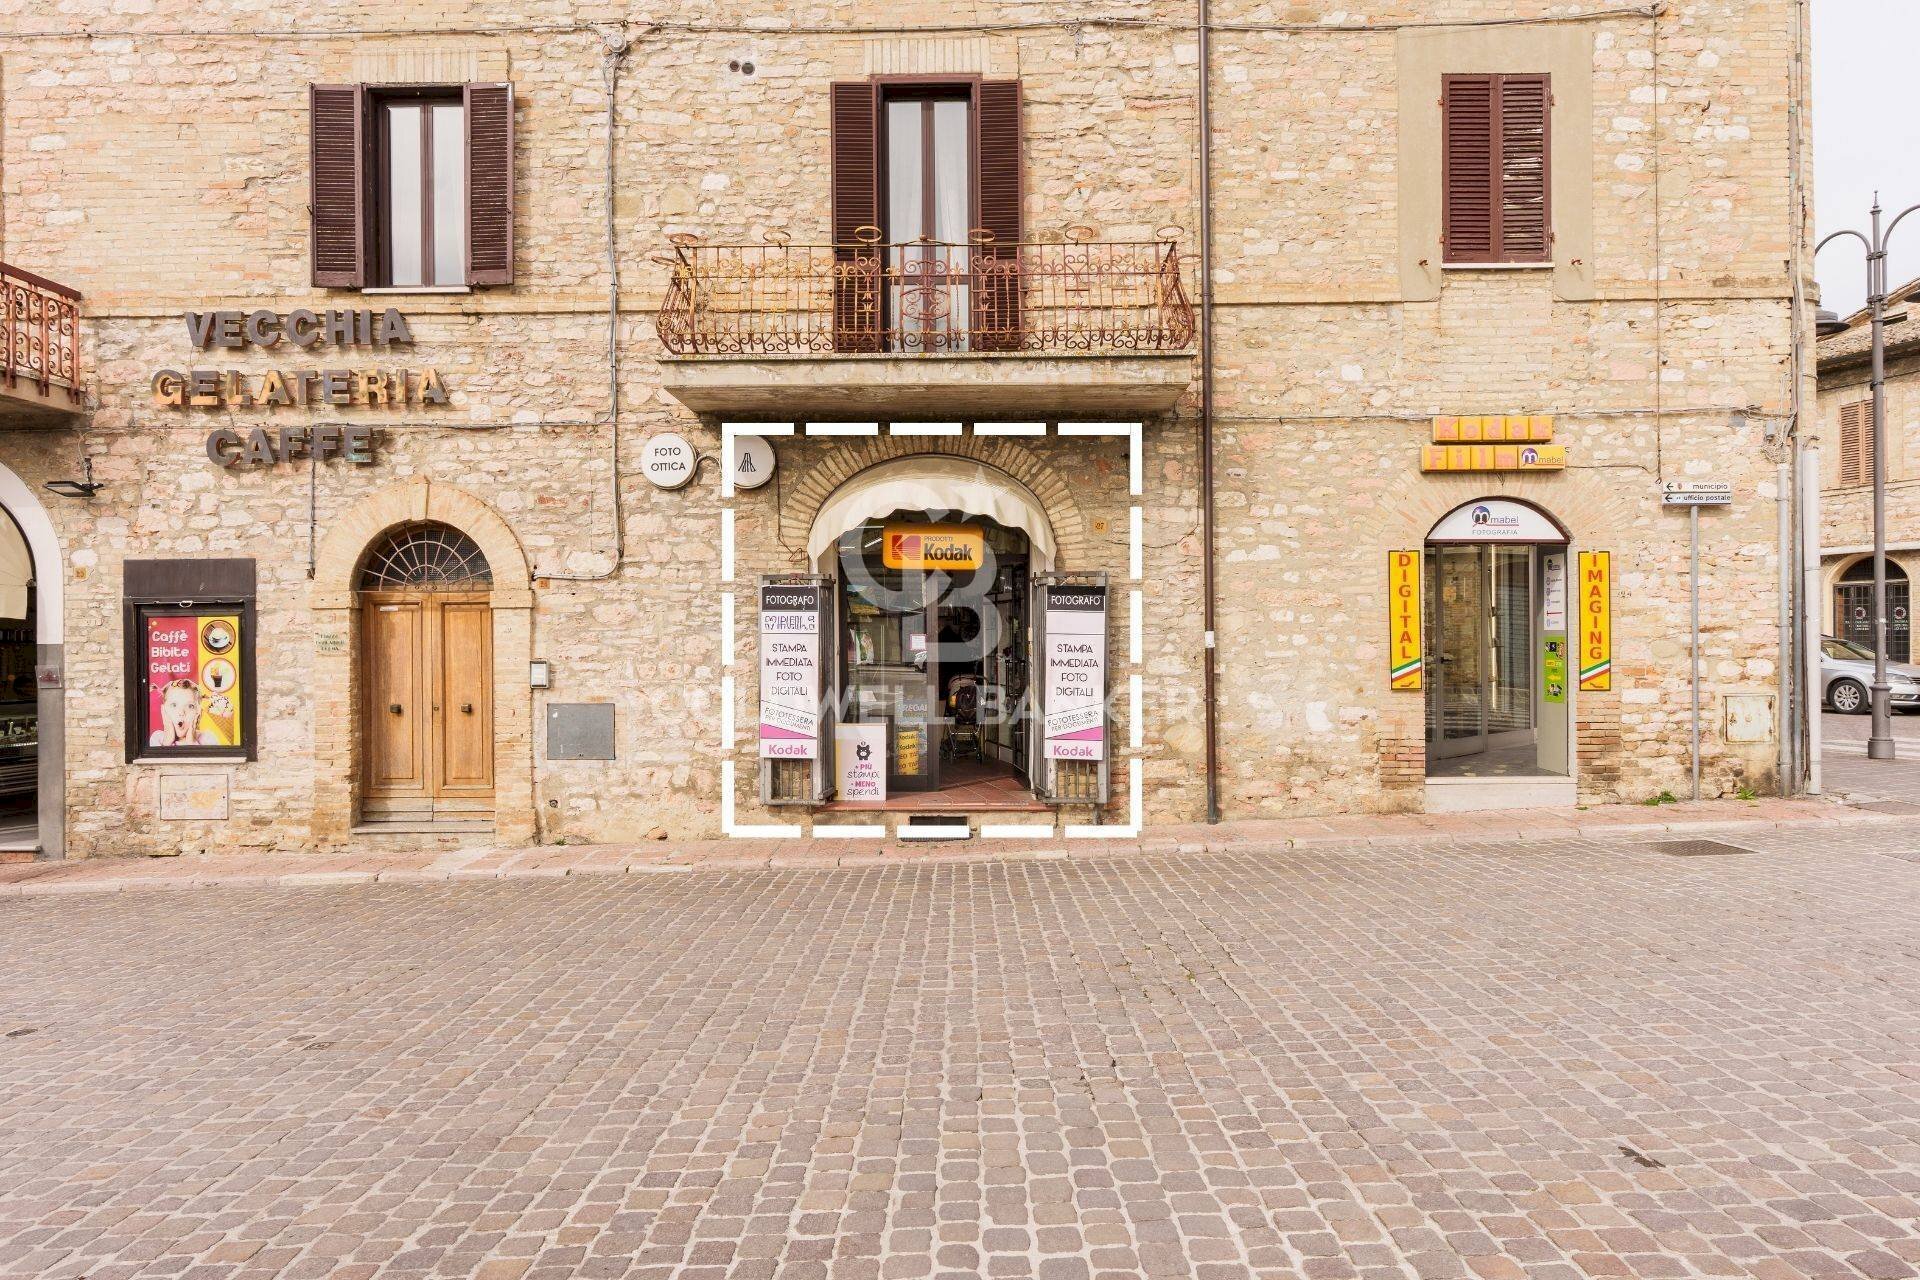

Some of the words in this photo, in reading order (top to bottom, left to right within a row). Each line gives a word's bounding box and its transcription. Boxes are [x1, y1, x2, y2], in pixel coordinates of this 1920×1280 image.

[184, 309, 413, 349] VECCHIA
[151, 369, 450, 406] GELATERIA
[1438, 418, 1549, 439] Kodak
[654, 446, 681, 456] FOTO
[1429, 448, 1517, 468] Film
[1538, 455, 1564, 464] mabel
[650, 461, 686, 472] OTTICA
[1692, 483, 1728, 491] municipio
[1683, 493, 1704, 501] ufficio
[1705, 493, 1731, 502] postale
[1490, 514, 1519, 524] mabel
[1471, 528, 1519, 536] FOTOGRAFIA
[924, 542, 973, 562] Kodak
[765, 595, 815, 605] FOTOGRAFO
[1051, 595, 1101, 605] FOTOGRAFO
[1398, 553, 1412, 659] DIGITAL
[1587, 554, 1603, 660] IMAGING
[151, 629, 188, 643] Caffè
[151, 646, 190, 657] Bibite
[772, 643, 807, 653] STAMPA
[1056, 643, 1093, 653] STAMPA
[150, 661, 191, 673] Gelati
[765, 657, 813, 667] IMMEDIATA
[1050, 658, 1099, 668] IMMEDIATA
[776, 671, 803, 681] FOTO
[1061, 672, 1088, 682] FOTO
[771, 686, 808, 696] DIGITALI
[1056, 686, 1093, 697] DIGITALI
[764, 707, 814, 726] FOTOTESSERA
[1047, 710, 1099, 727] FOTOTESSERA
[768, 744, 808, 755] Kodak
[1053, 745, 1093, 757] Kodak
[847, 787, 880, 797] spendi
